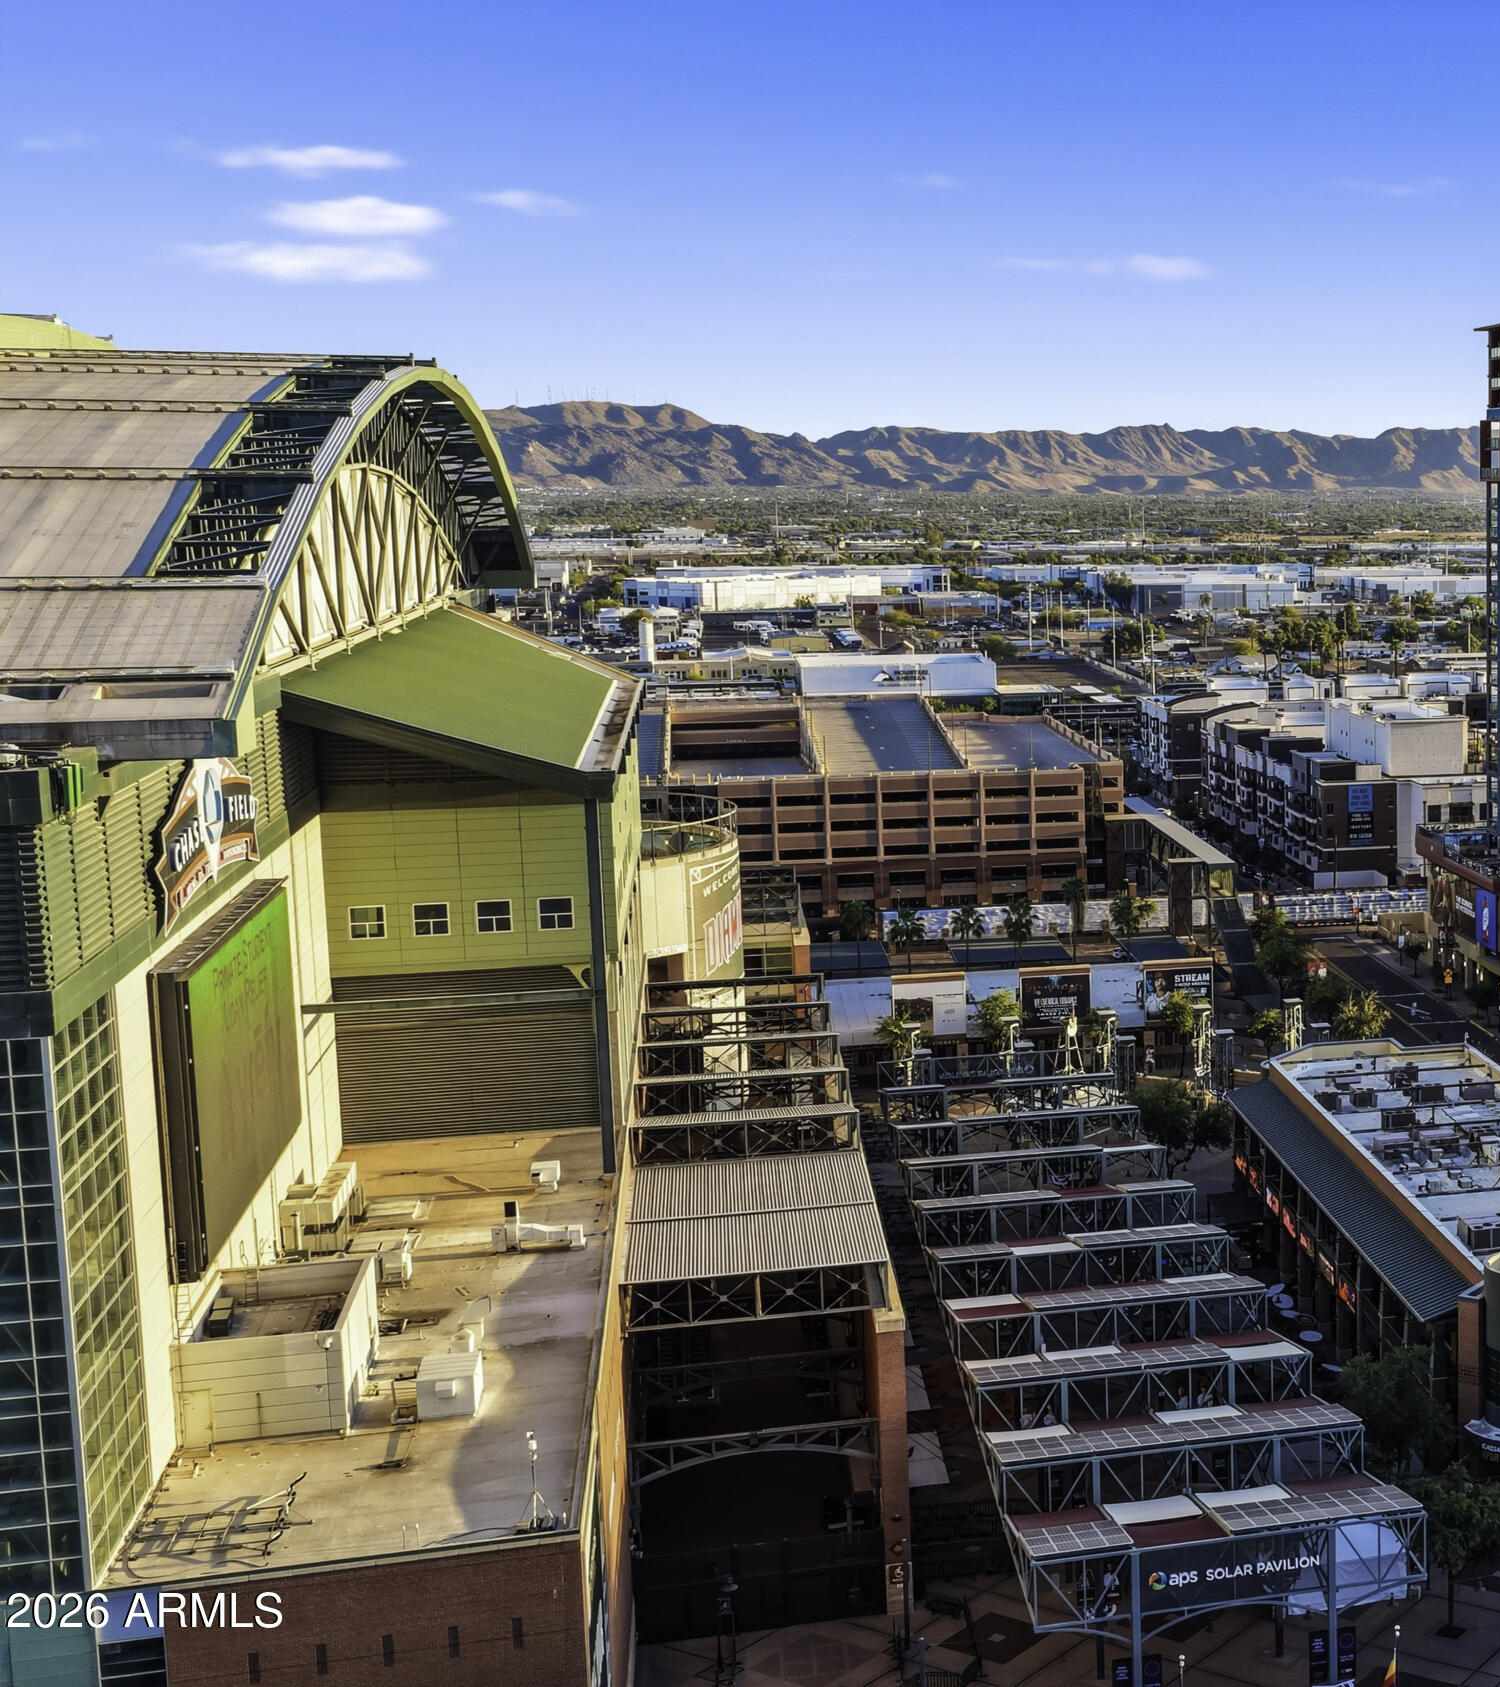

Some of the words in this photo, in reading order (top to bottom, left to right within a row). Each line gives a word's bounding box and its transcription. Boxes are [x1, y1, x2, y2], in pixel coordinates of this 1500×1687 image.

[229, 794, 257, 823] FIELD
[1169, 1570, 1198, 1587] aps
[1205, 1564, 1253, 1581] SOLAR
[1256, 1555, 1321, 1575] PAVILION
